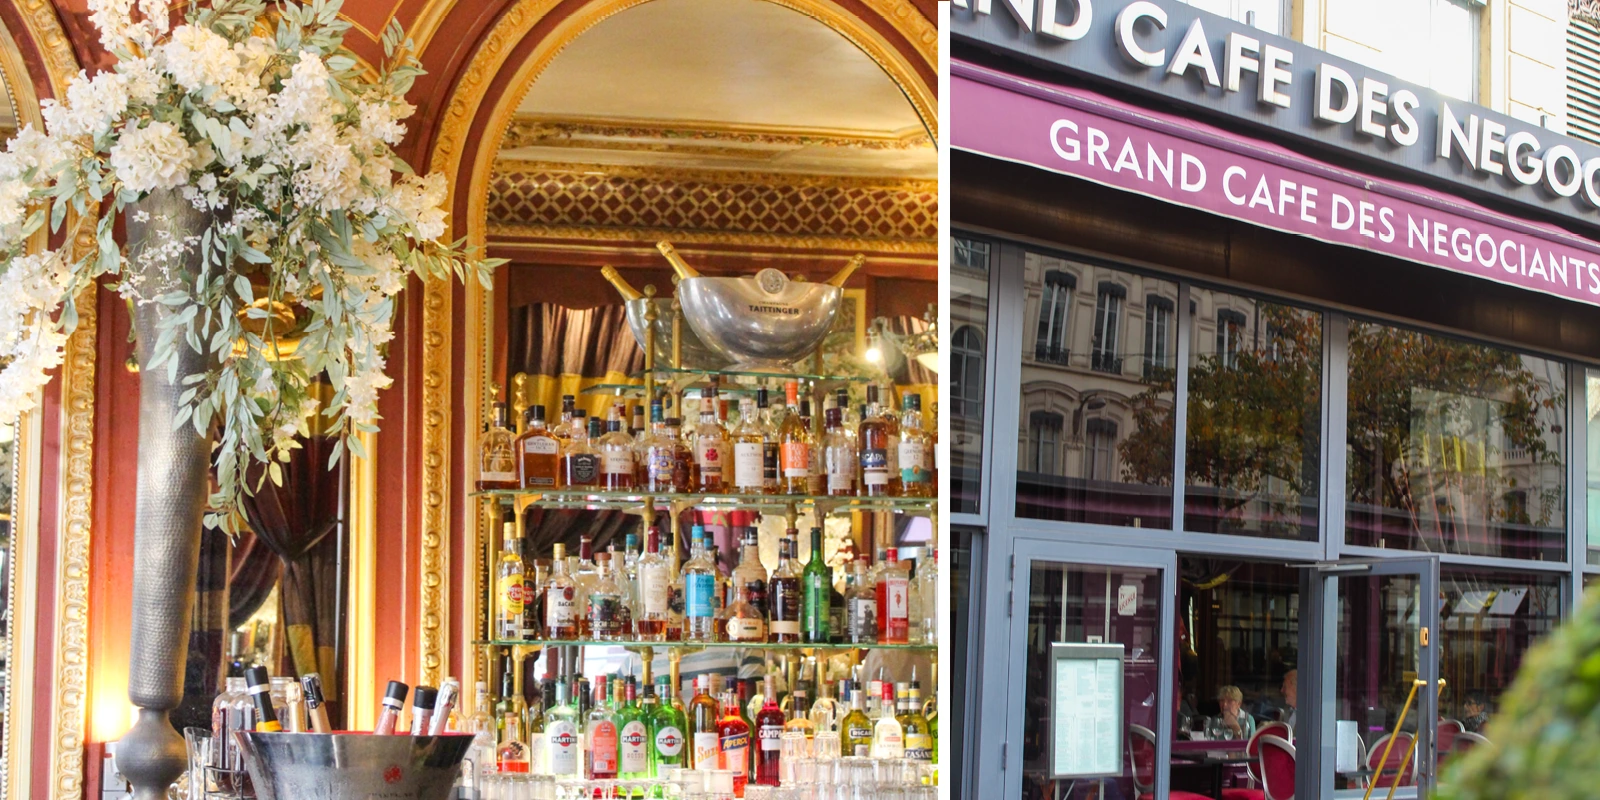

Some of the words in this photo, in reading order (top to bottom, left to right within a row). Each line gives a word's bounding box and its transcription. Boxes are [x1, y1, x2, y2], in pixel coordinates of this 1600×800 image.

[1115, 4, 1294, 108] CAFE
[1314, 63, 1420, 146] DES
[1050, 119, 1207, 192] GRAND
[1222, 166, 1318, 224] CAFE
[1331, 193, 1396, 243] DES
[1408, 213, 1600, 295] NEGOCIANTS
[749, 304, 800, 314] TAITTINGER
[723, 737, 747, 749] APEROL
